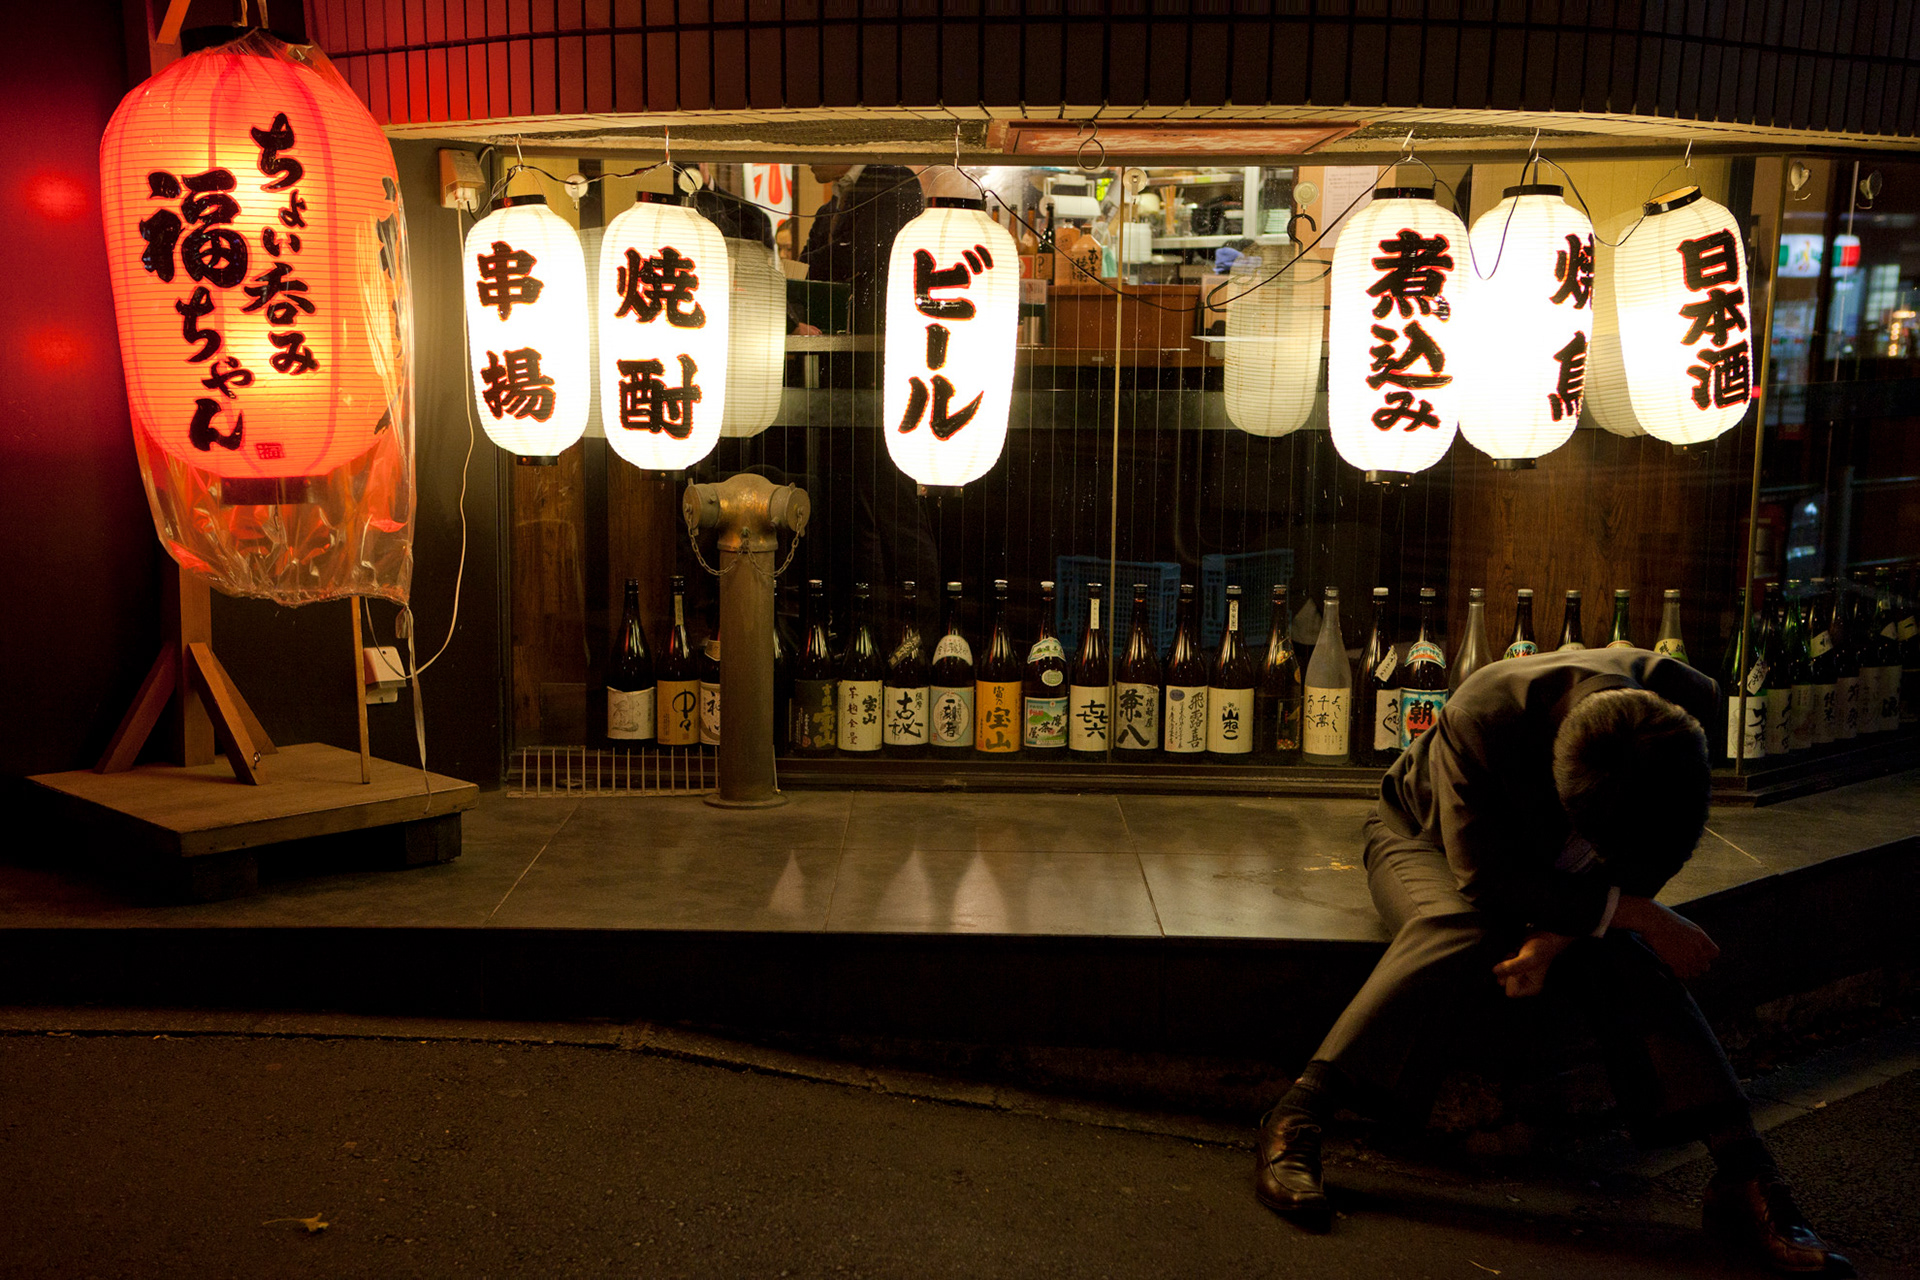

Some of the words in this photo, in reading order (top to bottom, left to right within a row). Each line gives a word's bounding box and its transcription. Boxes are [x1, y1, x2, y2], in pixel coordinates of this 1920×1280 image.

[138, 168, 254, 452] 福ちゃん
[242, 112, 319, 374] ちょい呑み
[476, 241, 556, 423] 串揚
[1366, 228, 1454, 432] 煮込み
[1677, 228, 1753, 410] 日本酒
[614, 246, 706, 440] 焼酎
[898, 244, 994, 441] ビール
[862, 695, 877, 725] 宝山
[1117, 688, 1150, 747] 兼八
[1187, 691, 1204, 749] 飛露喜
